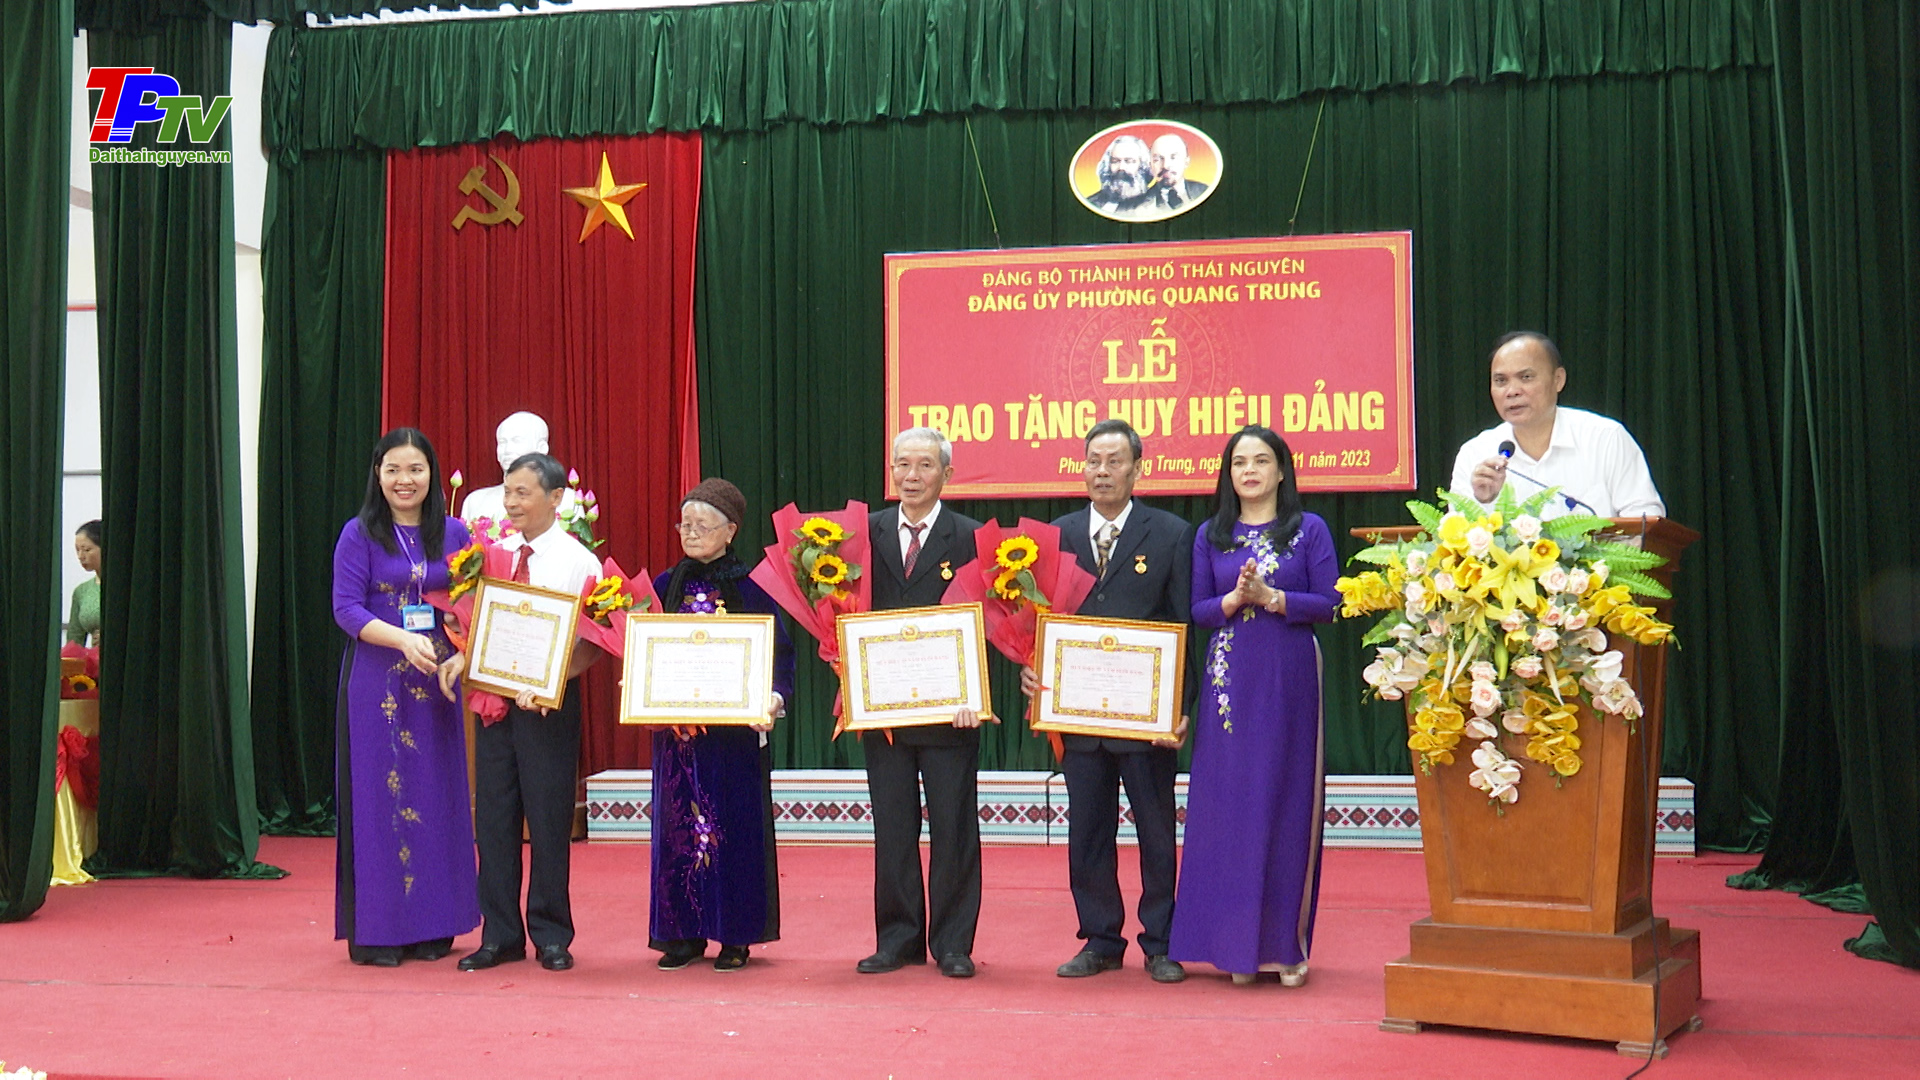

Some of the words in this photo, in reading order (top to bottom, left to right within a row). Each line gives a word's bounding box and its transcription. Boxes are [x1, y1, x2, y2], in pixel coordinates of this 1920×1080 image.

[982, 269, 1032, 287] ĐẢNG
[1038, 267, 1063, 286] BỘ
[1068, 265, 1131, 284] THÀNH
[1137, 260, 1175, 280] PHỐ
[1179, 260, 1224, 278] THÁI
[1230, 257, 1305, 277] NGUYÊN
[967, 290, 1027, 313] ĐẢNG
[1033, 288, 1061, 310] ỦY
[1066, 285, 1156, 309] PHƯỜNG
[1162, 284, 1239, 308] QUANG
[1245, 281, 1321, 301] TRUNG
[1102, 317, 1177, 384] LỄ
[908, 403, 994, 443] TRAO
[1004, 393, 1097, 449] TẶNG
[1108, 397, 1178, 438] HUY
[1282, 379, 1385, 433] ĐẢNG
[1156, 454, 1195, 474] Trung,
[1199, 454, 1223, 474] ngà
[1309, 451, 1337, 468] năm
[1341, 450, 1371, 467] 2023
